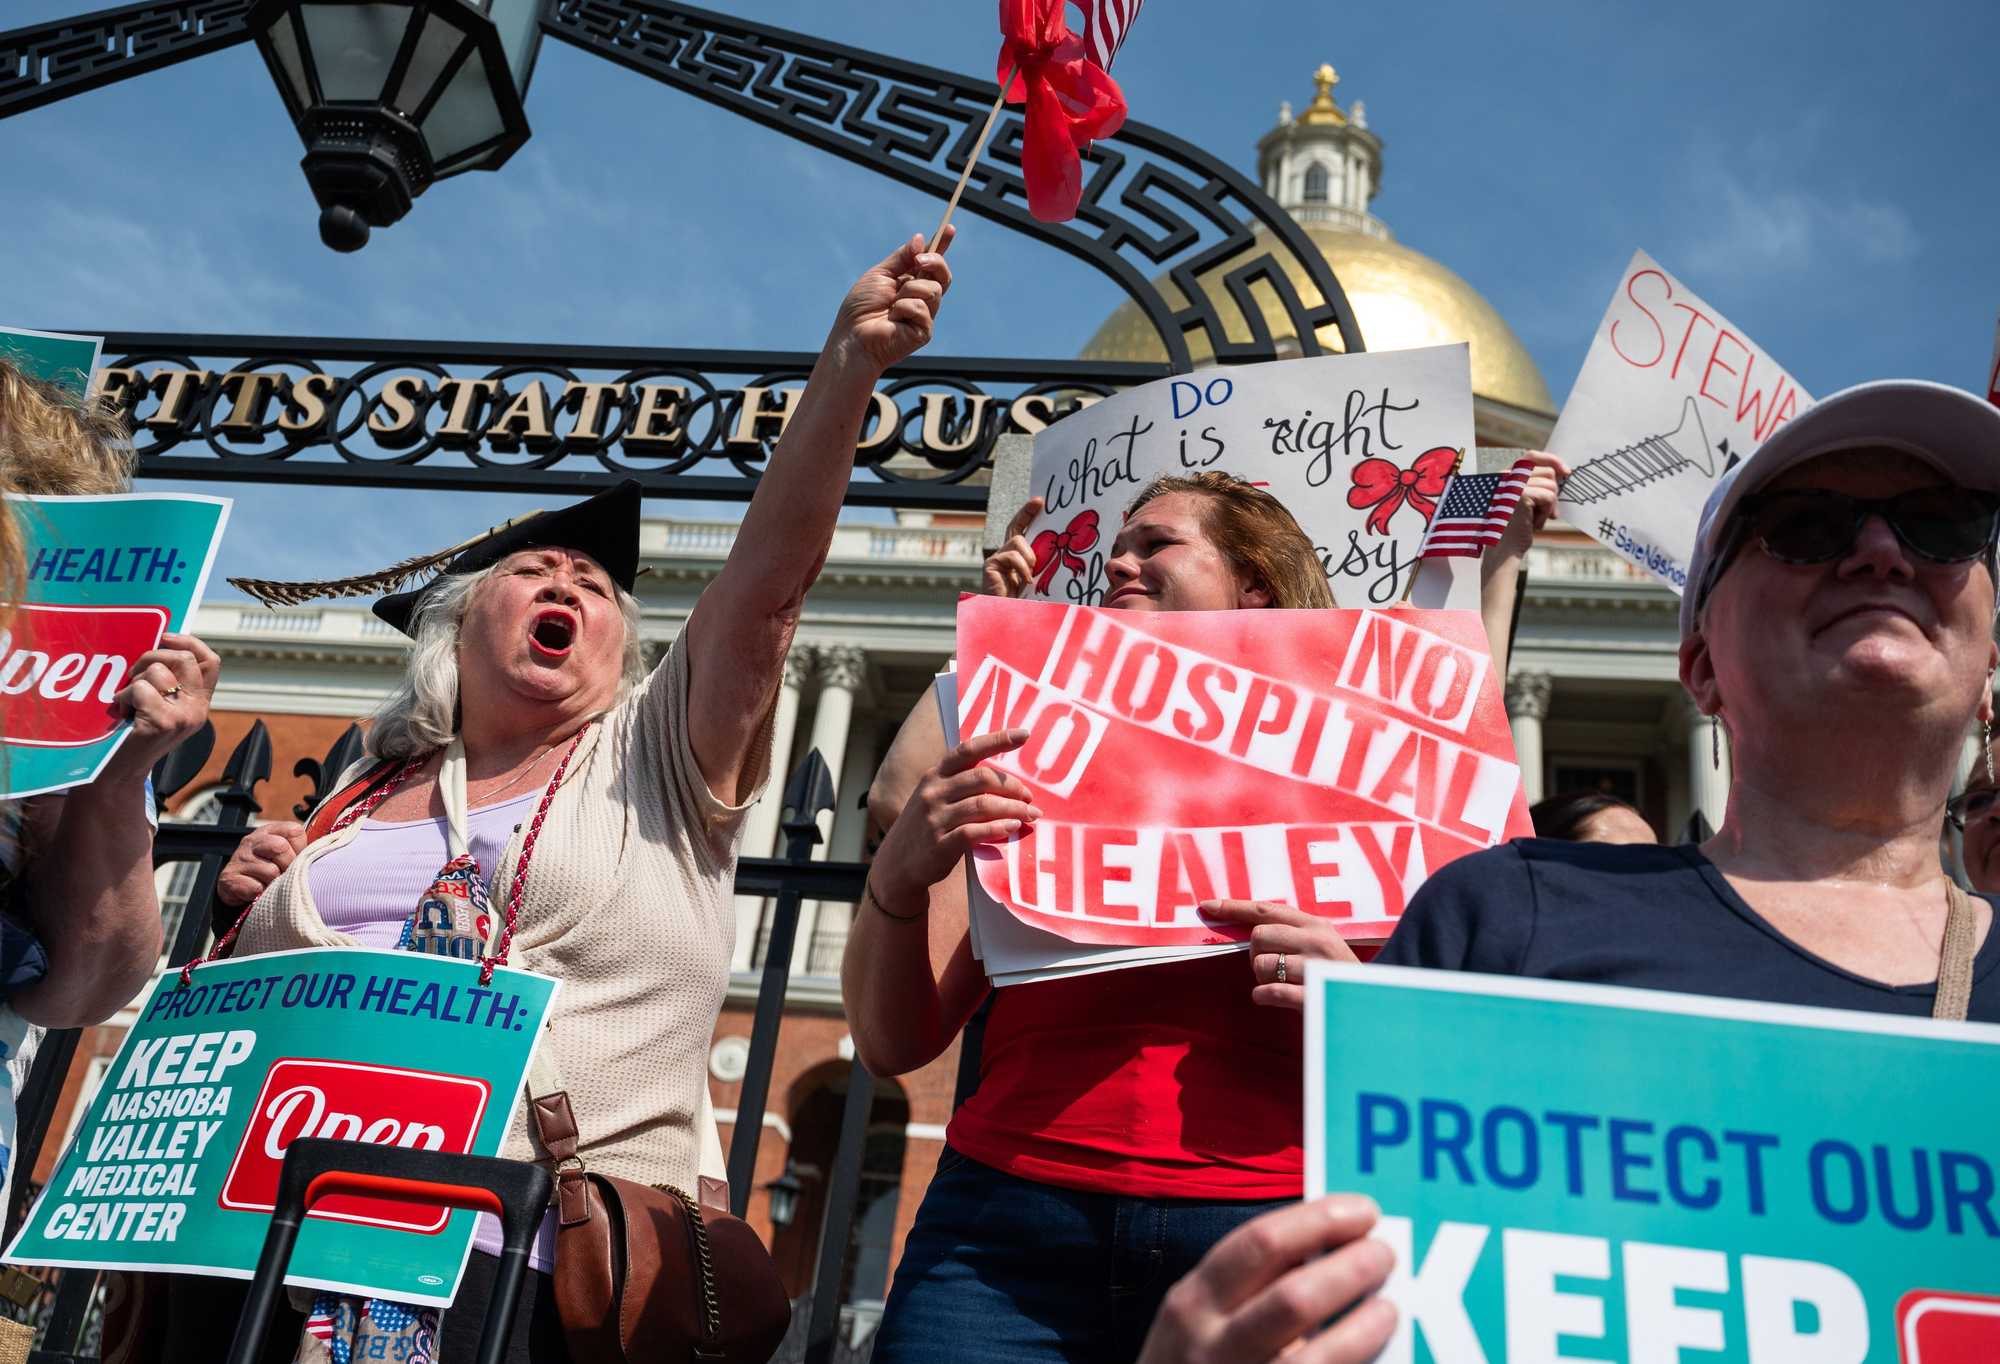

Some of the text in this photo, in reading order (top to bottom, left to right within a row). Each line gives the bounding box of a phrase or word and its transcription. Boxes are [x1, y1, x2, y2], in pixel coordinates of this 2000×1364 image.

[367, 378, 687, 449] STATE
[727, 386, 1104, 453] HOUS
[1170, 377, 1234, 420] DO
[1044, 415, 1154, 515] what
[1179, 426, 1226, 468] is
[29, 547, 187, 585] HEALTH:
[1313, 530, 1416, 604] asy
[1349, 616, 1474, 721] NO
[960, 664, 1092, 785] NO
[1049, 605, 1492, 844] HOSPITAL
[1017, 824, 1415, 922] HEALEY
[148, 973, 527, 1032] PROTECT OUR HEALTH:
[117, 1029, 256, 1089] KEEP
[86, 1120, 223, 1162] VALLEY
[102, 1086, 232, 1122] NASHOBA
[64, 1163, 197, 1197] MEDICAL
[1356, 1092, 2000, 1237] PROTECT OUR
[43, 1202, 186, 1242] CENTER
[1372, 1216, 1870, 1364] KEEP
